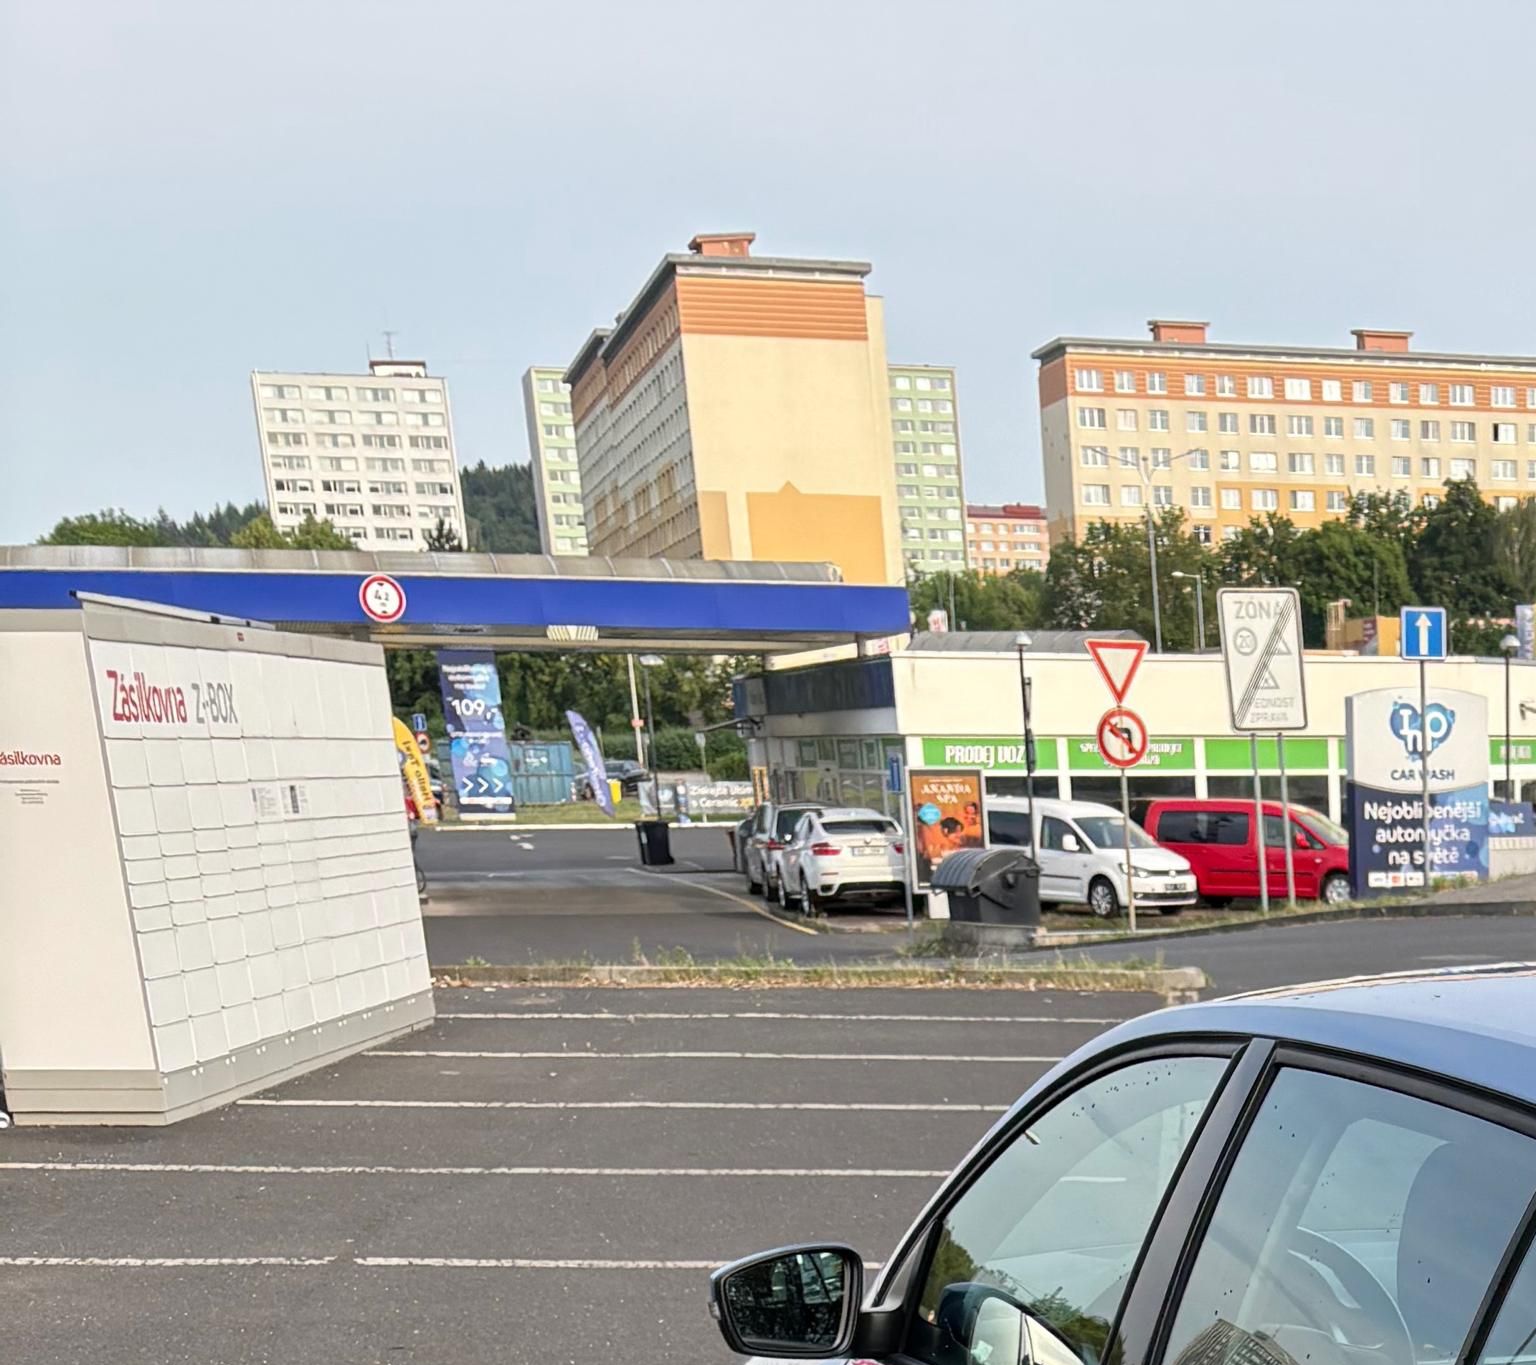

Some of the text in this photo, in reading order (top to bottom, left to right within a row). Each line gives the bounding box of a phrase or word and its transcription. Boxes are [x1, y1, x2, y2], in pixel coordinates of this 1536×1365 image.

[106, 669, 188, 723] Zásilkovna
[0, 750, 61, 766] ásilkovna
[945, 744, 1027, 768] PRODEJ VOZ
[1390, 769, 1416, 781] CAR
[1388, 851, 1410, 865] na
